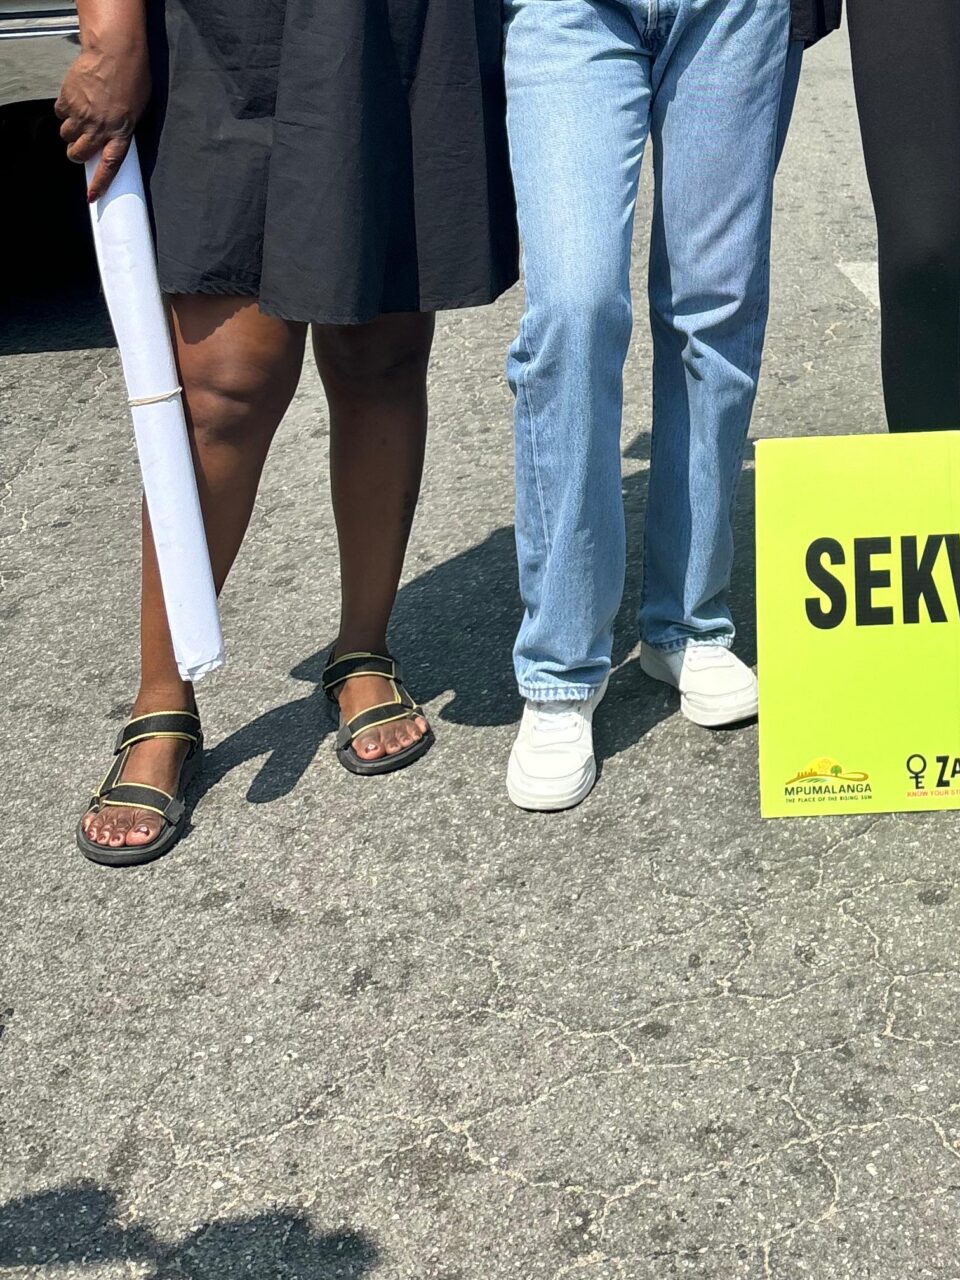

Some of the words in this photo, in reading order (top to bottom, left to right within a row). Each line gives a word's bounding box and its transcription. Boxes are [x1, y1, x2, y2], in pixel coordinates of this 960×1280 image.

[784, 782, 873, 797] MPUMALANGA
[906, 790, 929, 798] KNOW
[930, 789, 949, 797] YOUR
